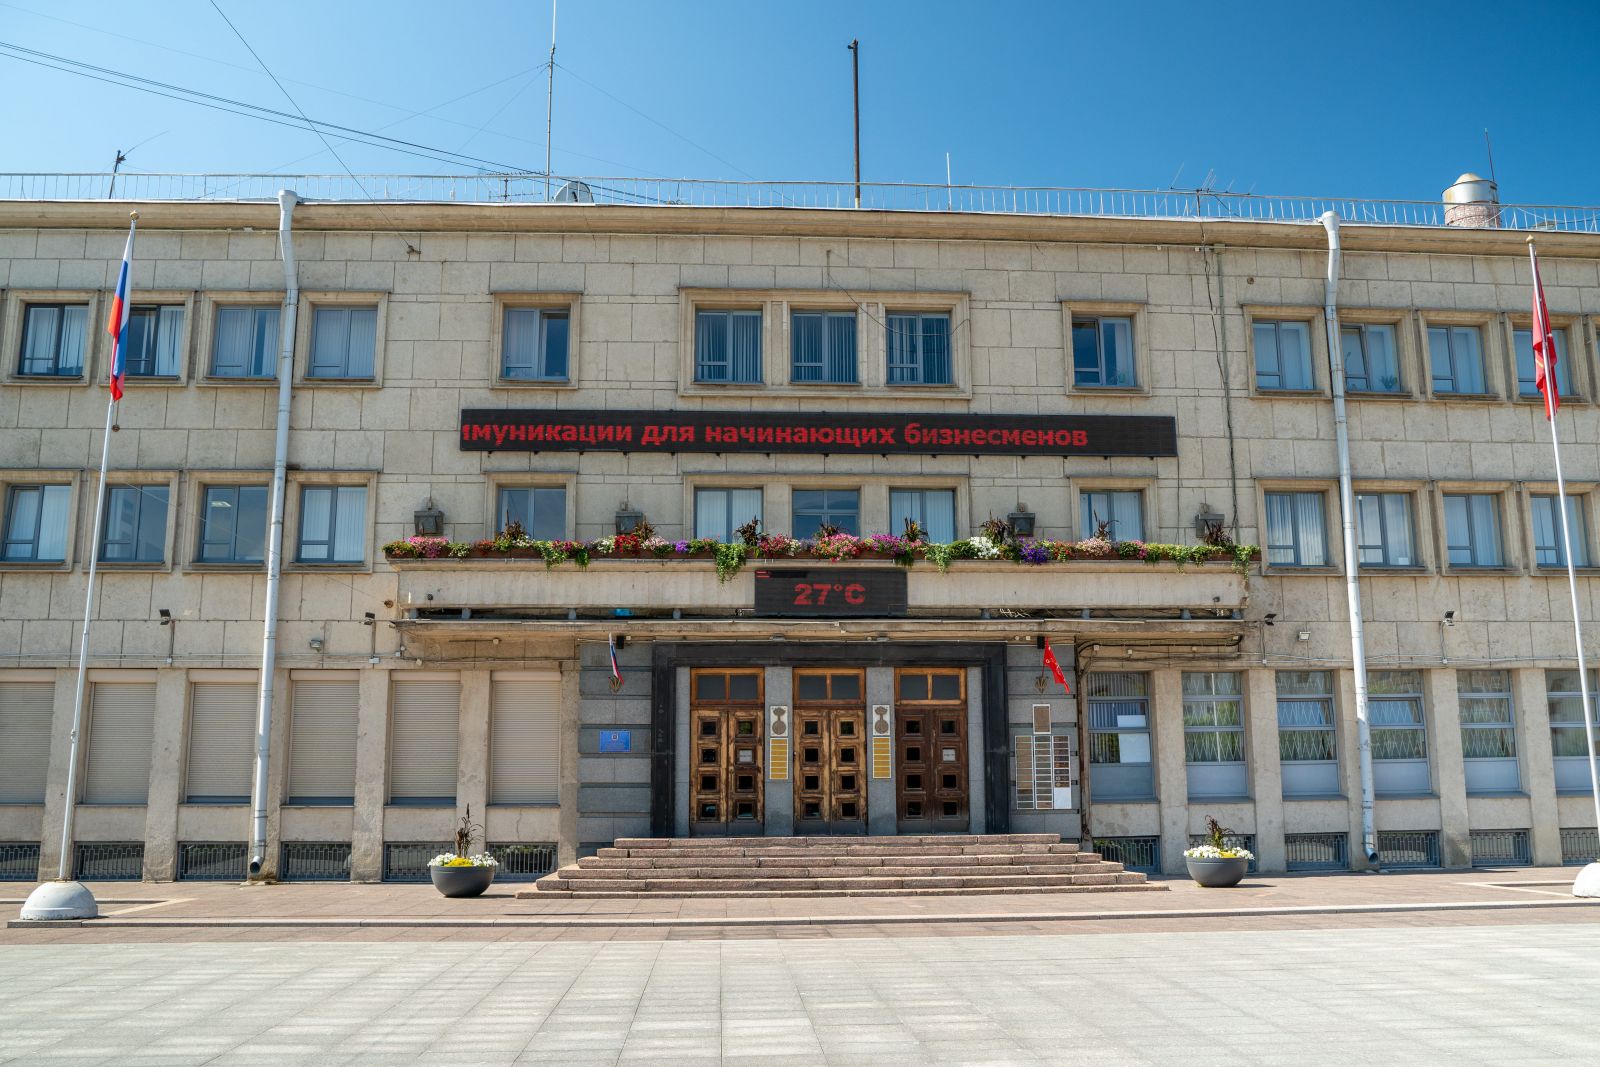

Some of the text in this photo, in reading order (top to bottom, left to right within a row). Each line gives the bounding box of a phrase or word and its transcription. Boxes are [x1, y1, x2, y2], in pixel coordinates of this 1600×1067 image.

[640, 425, 695, 446] для
[704, 425, 895, 448] начинающих
[904, 422, 1088, 447] бизнесменов
